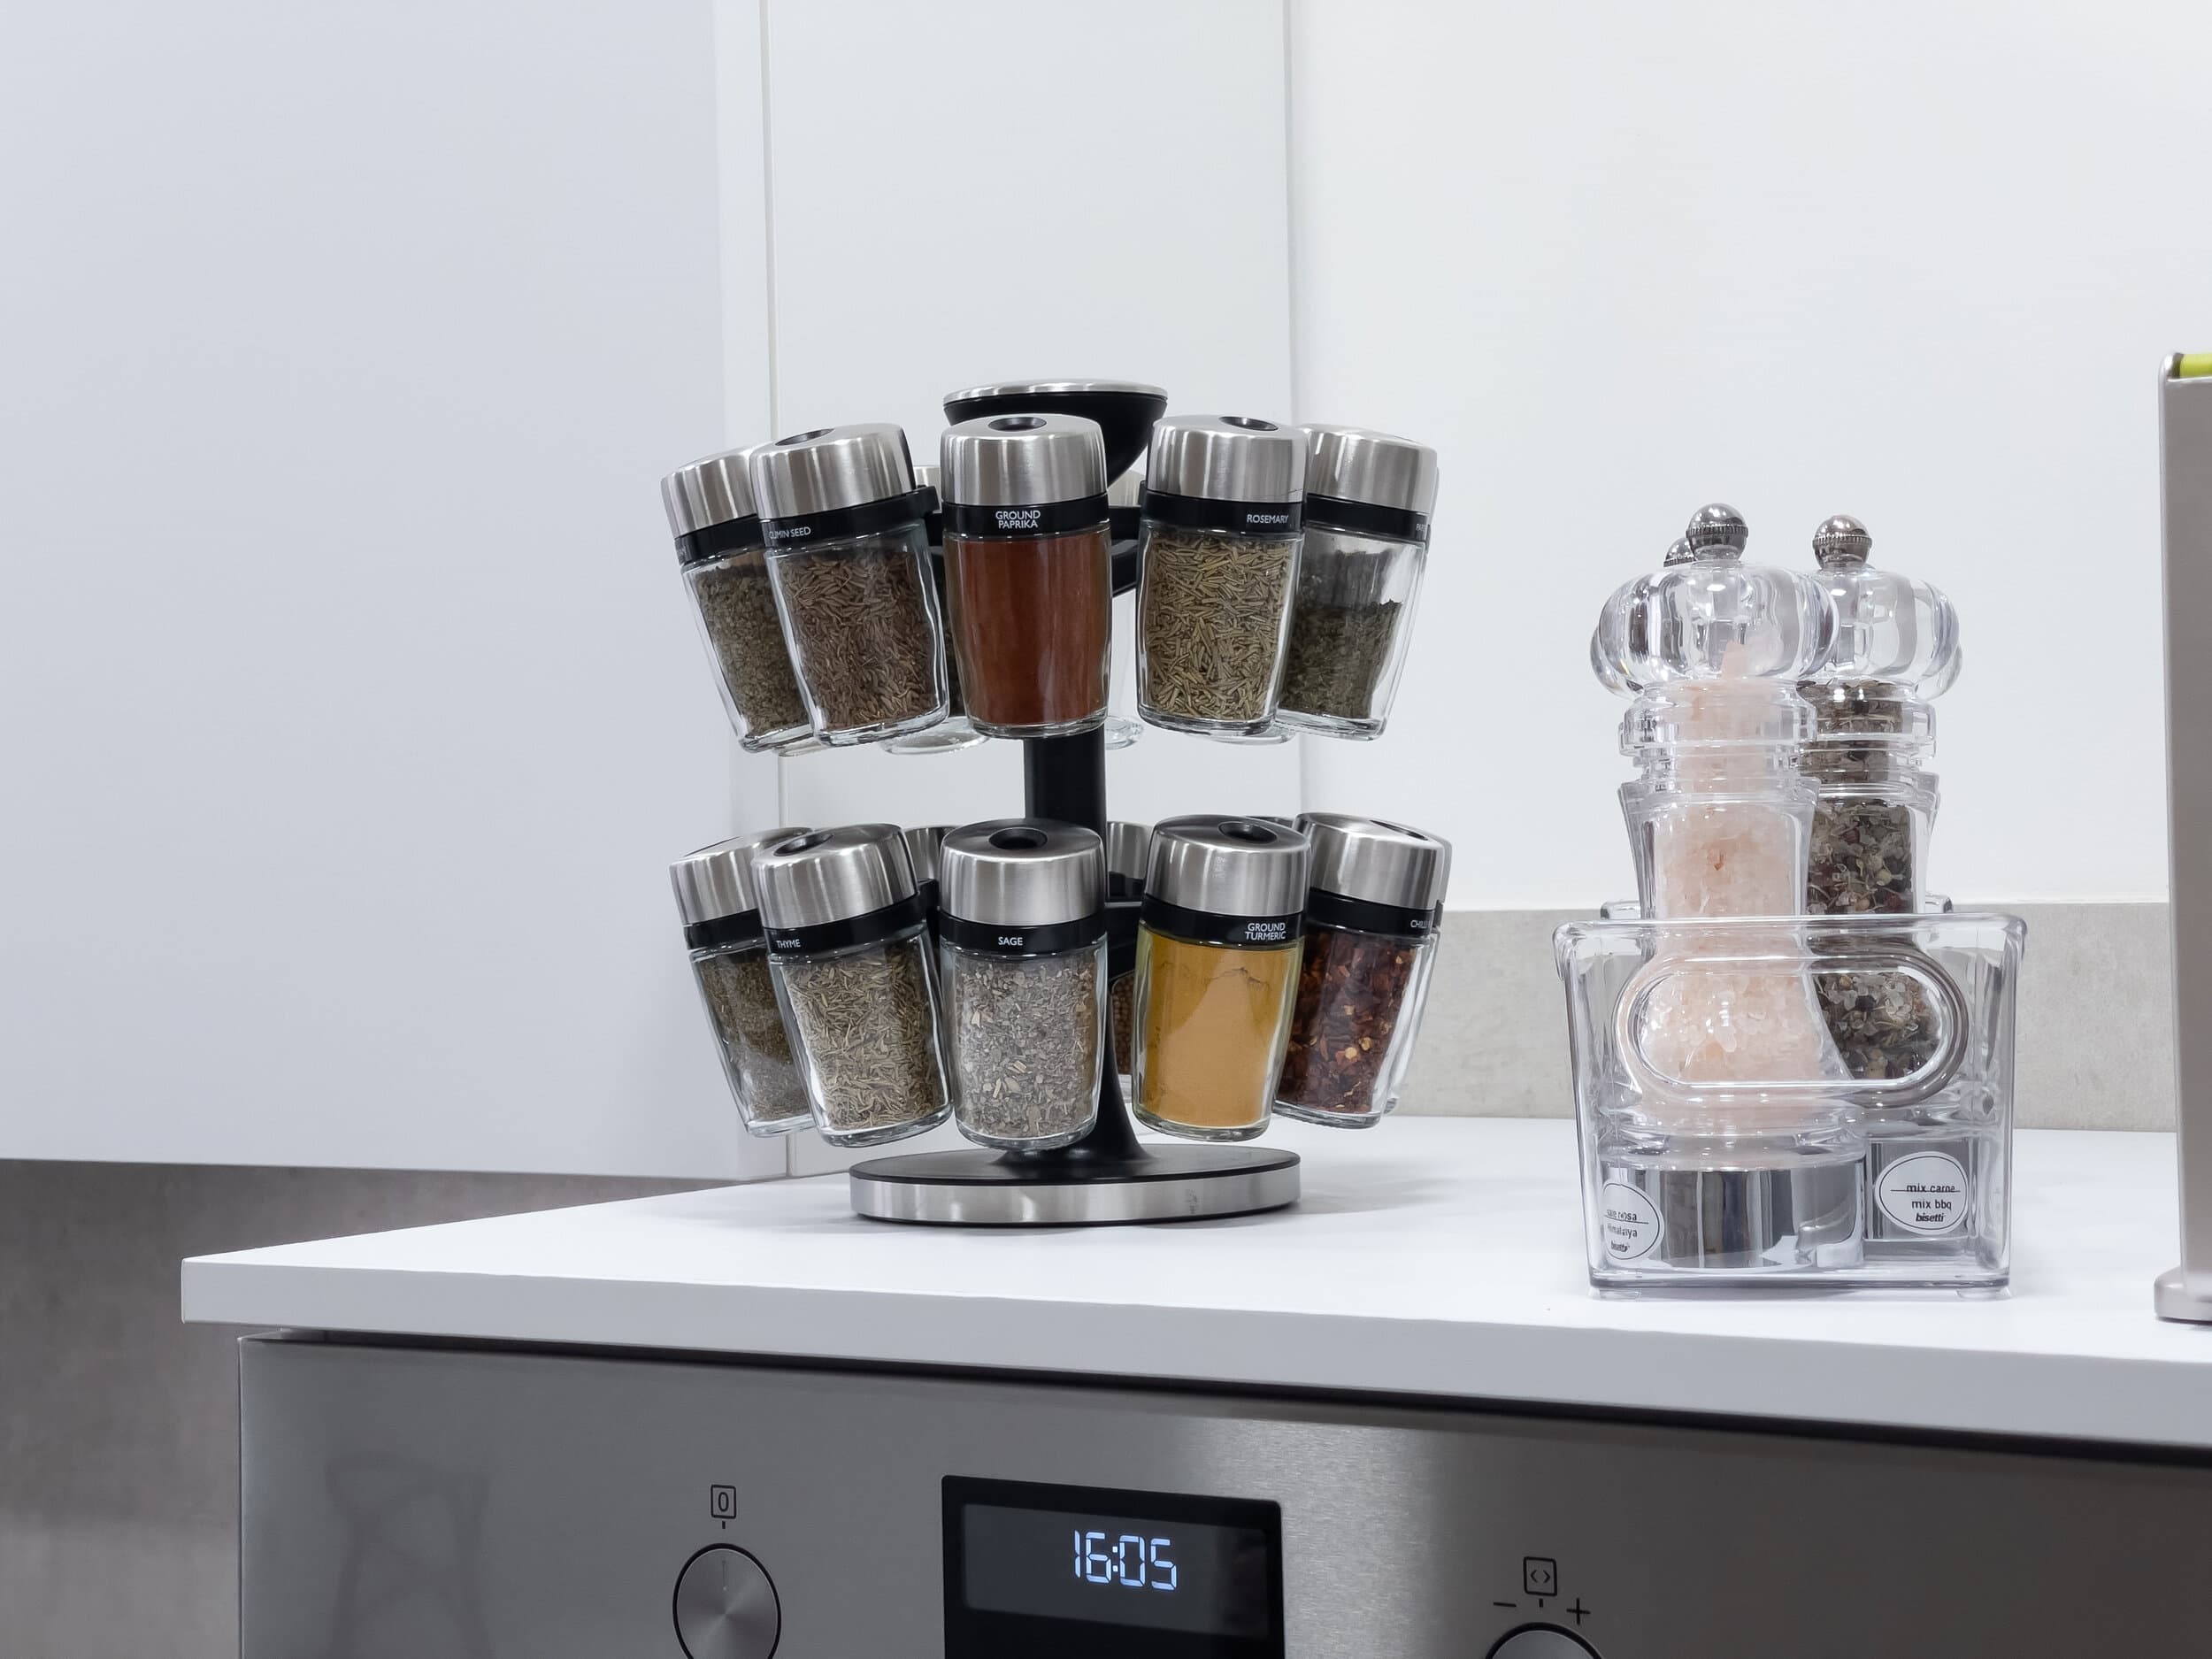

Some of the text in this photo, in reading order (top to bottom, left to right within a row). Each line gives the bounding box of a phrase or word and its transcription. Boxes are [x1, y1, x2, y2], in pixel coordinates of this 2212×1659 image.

[995, 511, 1041, 520] GROUND
[1247, 514, 1289, 523] ROSEMARY
[998, 519, 1039, 528] PAPRIKA
[790, 526, 811, 537] SEED
[1248, 923, 1286, 932] GROUND
[1245, 931, 1286, 940] TURMERIC
[776, 939, 801, 949] THYME
[998, 936, 1024, 946] SAGE
[1906, 1183, 1927, 1193] mix
[1911, 1199, 1952, 1210] mix bbq
[1916, 1212, 1945, 1222] bisetti
[1074, 1530, 1177, 1591] 16:05
